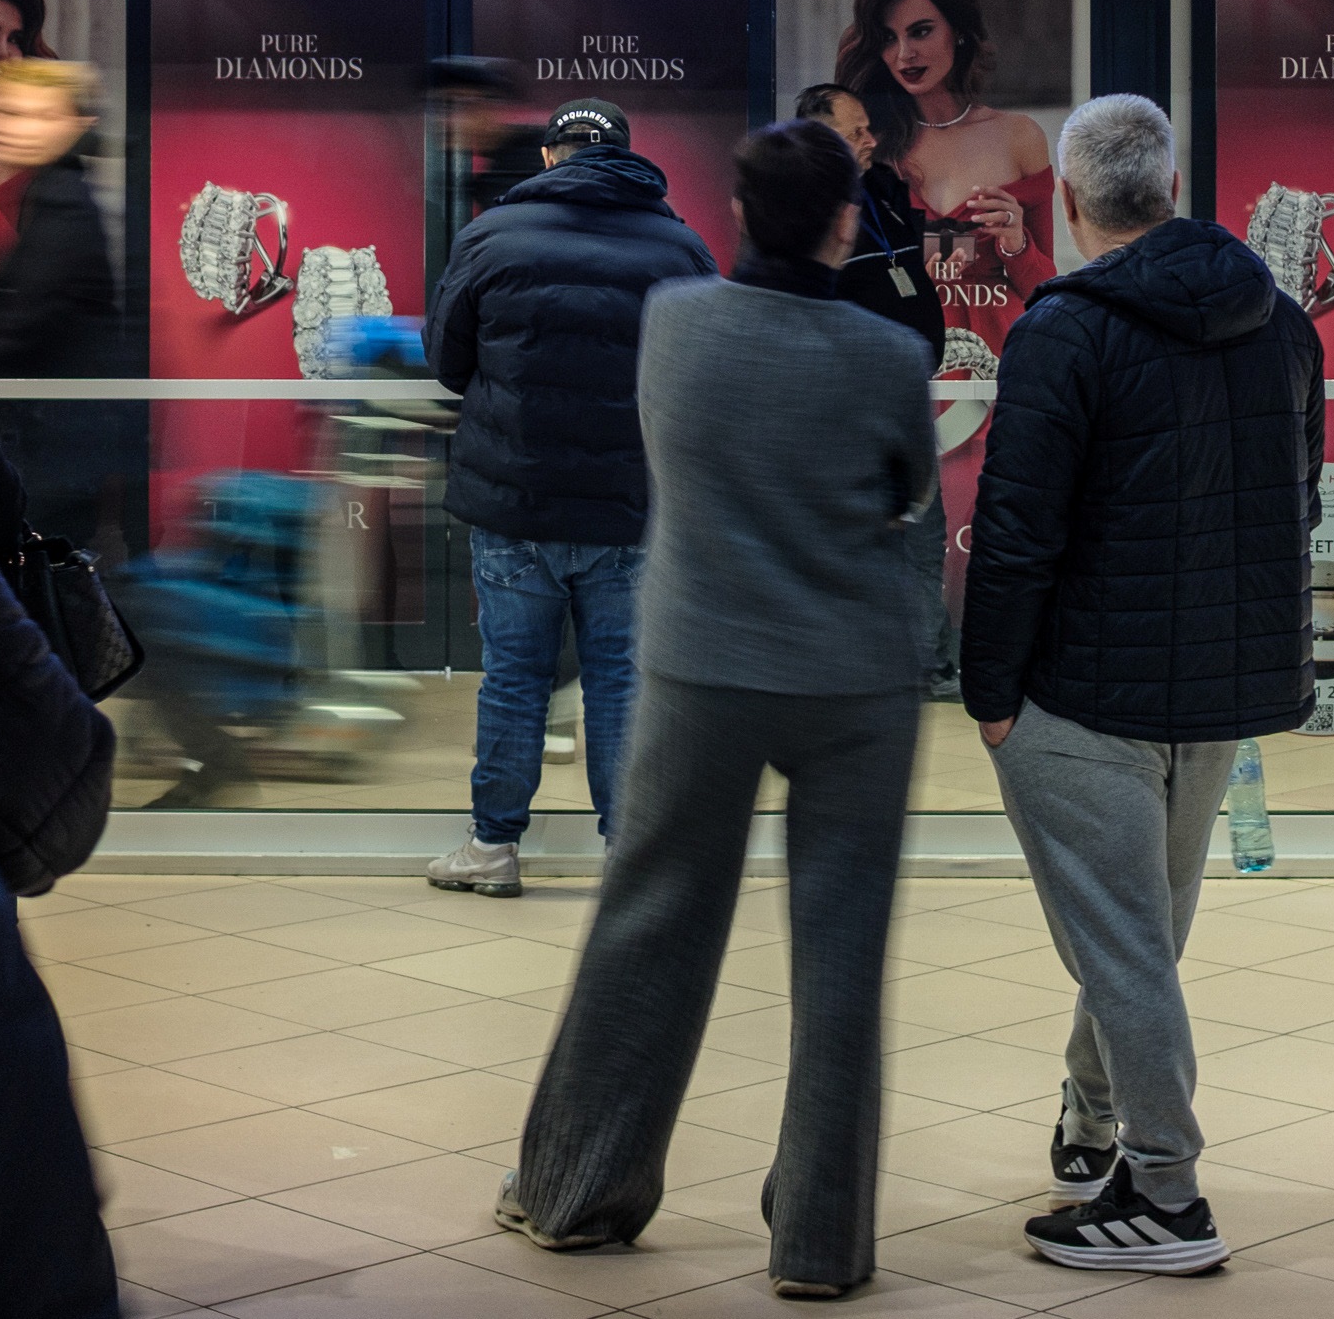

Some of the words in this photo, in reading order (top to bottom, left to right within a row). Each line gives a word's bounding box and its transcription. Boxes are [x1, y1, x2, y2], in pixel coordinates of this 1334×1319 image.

[261, 34, 318, 53] PURE
[582, 35, 639, 54] PURE
[215, 57, 364, 80] DIAMONDS
[536, 57, 685, 81] DIAMONDS
[934, 261, 963, 280] RE
[935, 284, 1009, 308] ONDS
